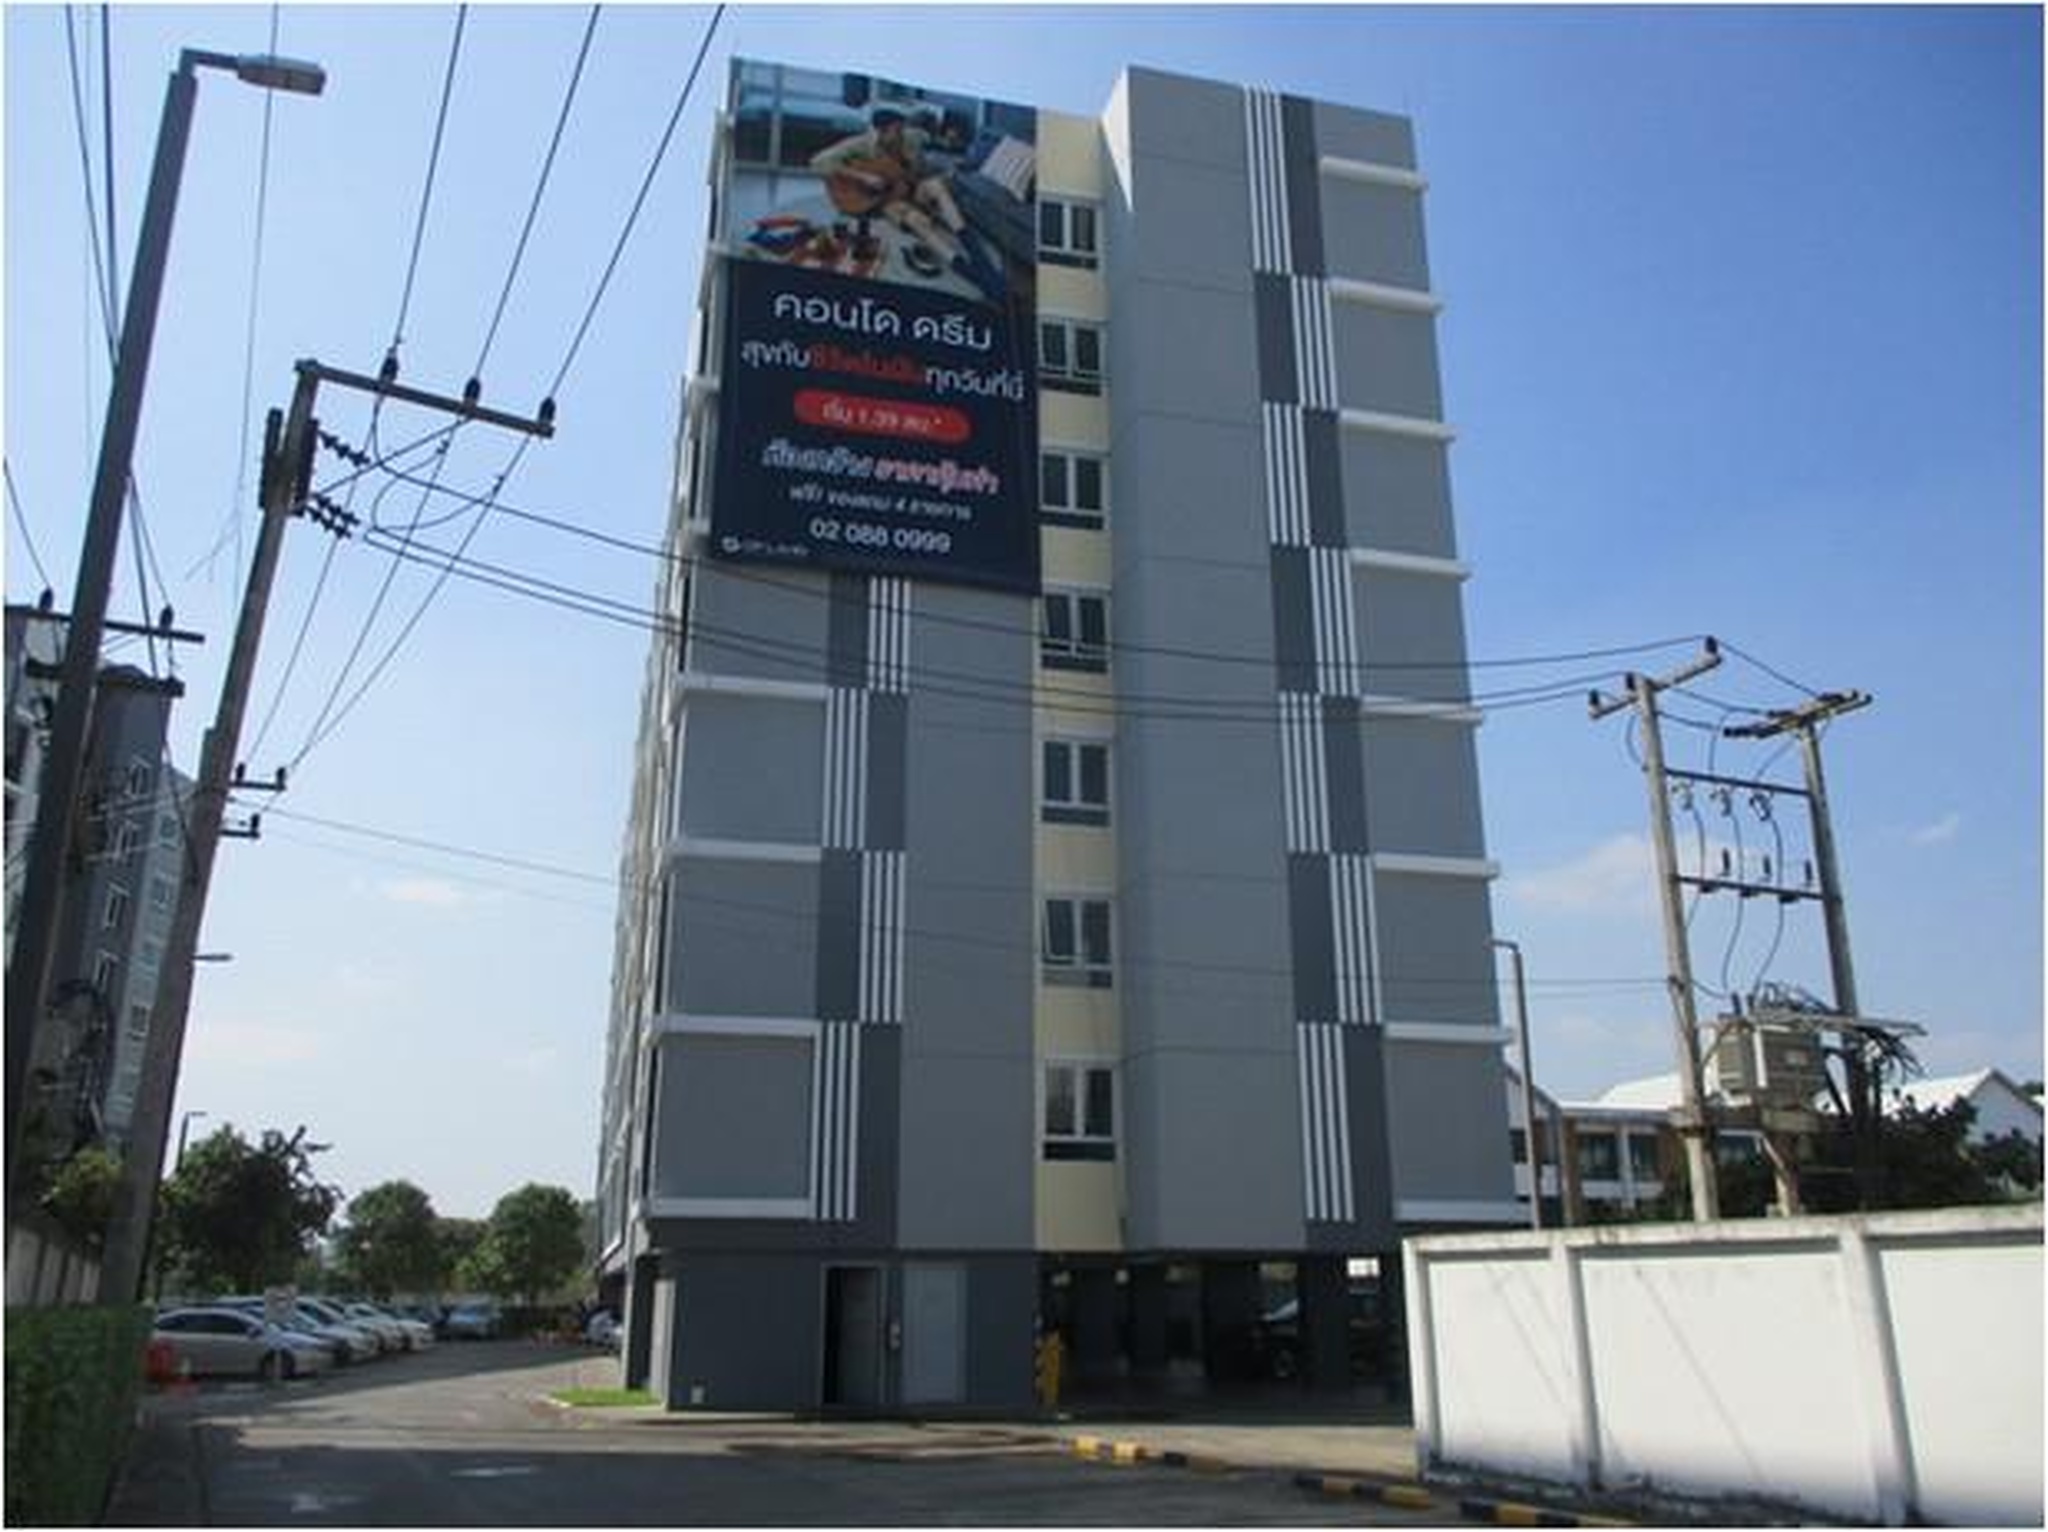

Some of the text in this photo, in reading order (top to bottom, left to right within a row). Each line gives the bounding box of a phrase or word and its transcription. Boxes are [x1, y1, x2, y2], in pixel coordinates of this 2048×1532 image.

[774, 293, 992, 350] คอนโด ดรีม
[809, 517, 953, 554] 02 088 0999
